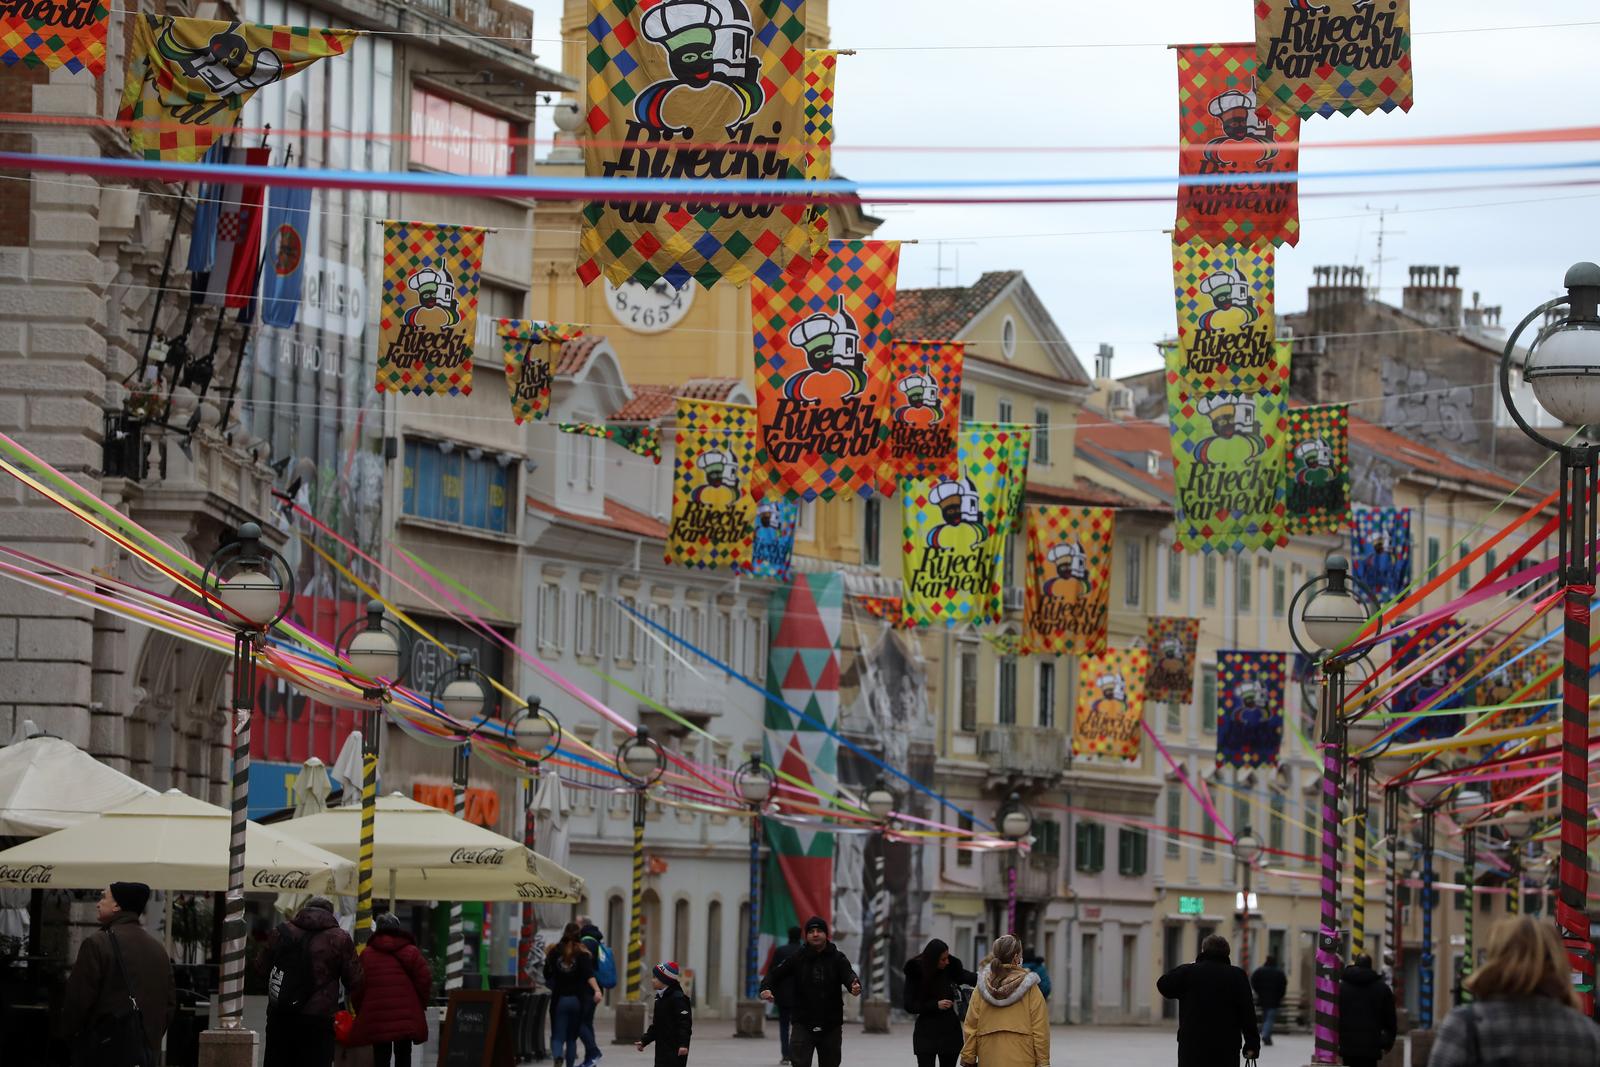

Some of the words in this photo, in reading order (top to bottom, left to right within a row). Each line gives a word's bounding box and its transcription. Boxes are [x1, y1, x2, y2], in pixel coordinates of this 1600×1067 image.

[1280, 1, 1397, 53] Riječki
[1266, 26, 1404, 79] karneval
[616, 292, 628, 311] 8
[631, 306, 641, 323] 7
[643, 309, 655, 327] 6
[659, 305, 670, 323] 5
[396, 324, 466, 351] Riječki
[1193, 326, 1268, 356] Riječki
[385, 342, 468, 369] karneval
[1186, 342, 1272, 374] karneval
[772, 394, 877, 440] Riječki
[762, 418, 881, 463] karneval
[1188, 460, 1278, 499] Riječki
[681, 501, 748, 529] Riječki
[1180, 484, 1279, 521] karneval
[670, 518, 750, 543] karneval
